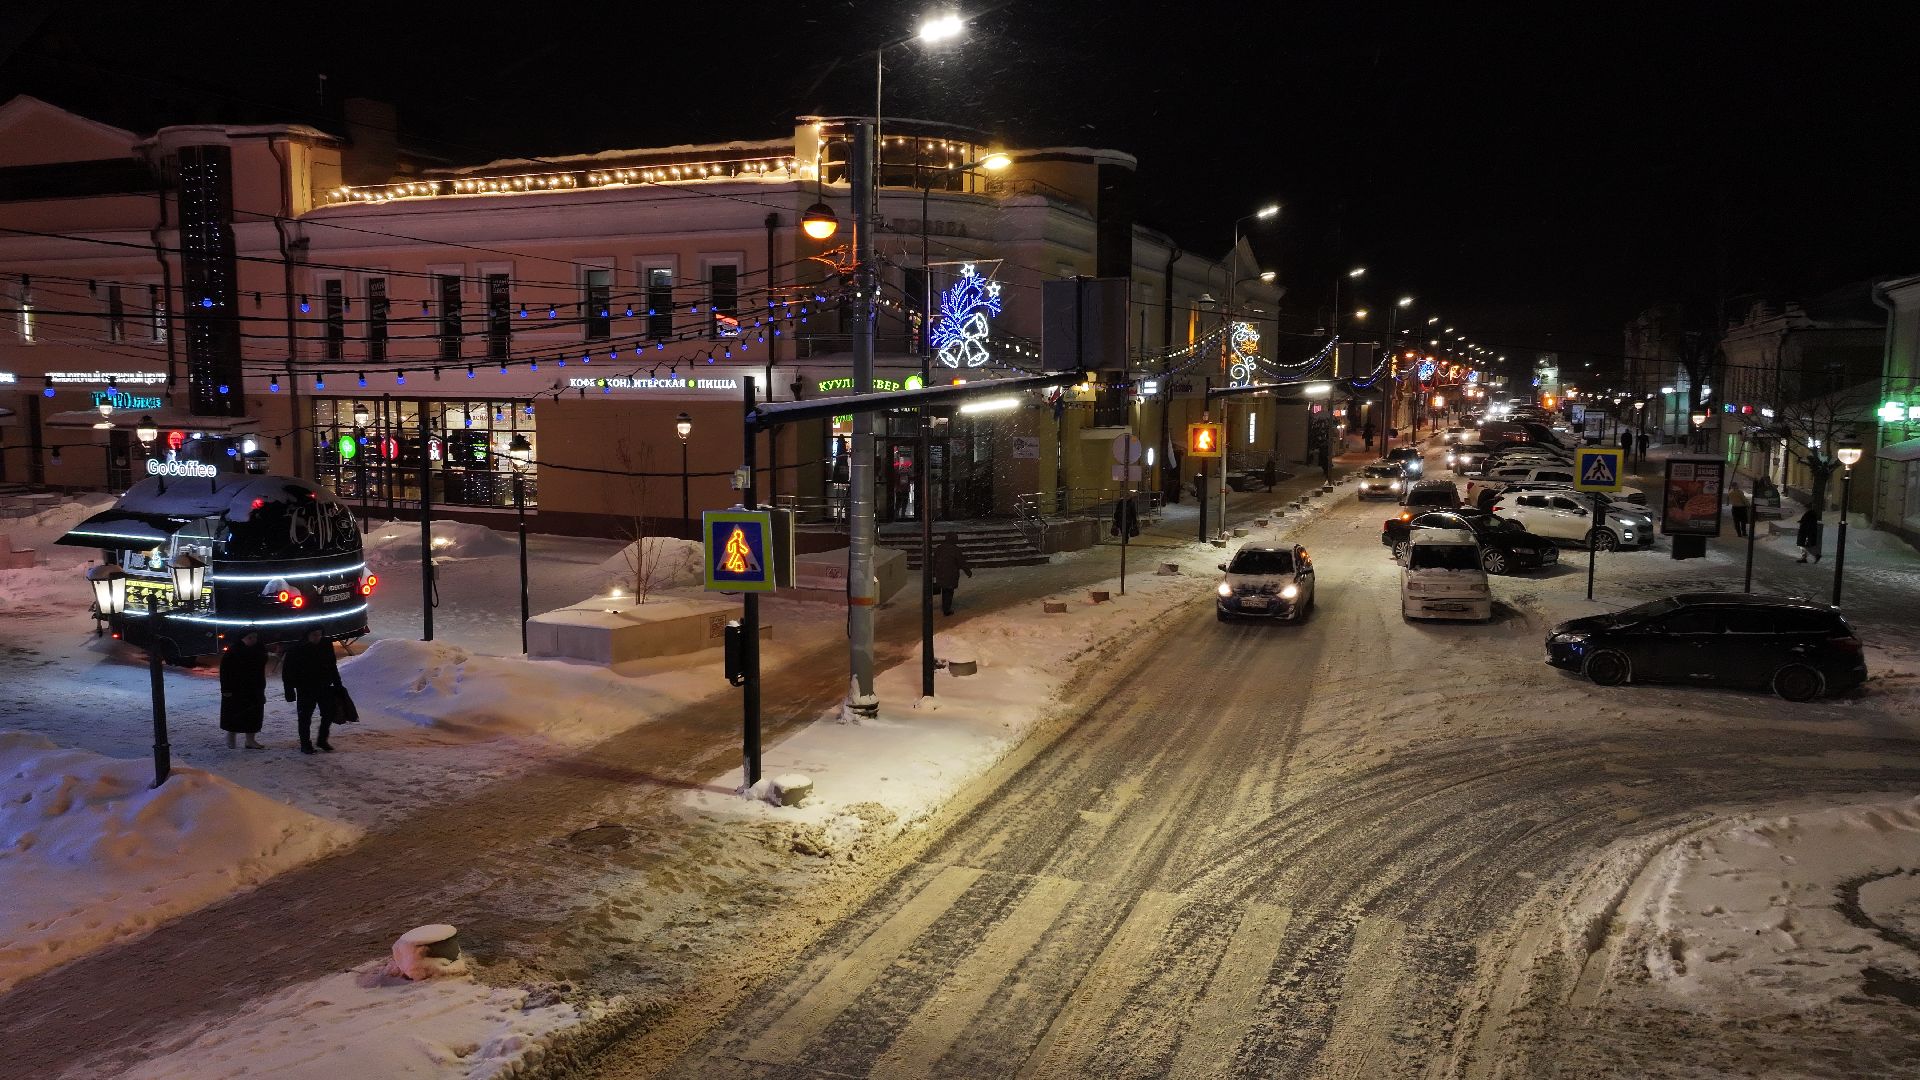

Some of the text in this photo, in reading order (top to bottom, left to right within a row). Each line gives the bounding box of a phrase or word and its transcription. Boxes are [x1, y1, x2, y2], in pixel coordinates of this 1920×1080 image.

[569, 378, 737, 389] КОФЕ КОНДИТЕРСКАЯ ПИЦЦА
[818, 378, 900, 392] КУУЛВЕР
[147, 458, 217, 477] GoCoffee
